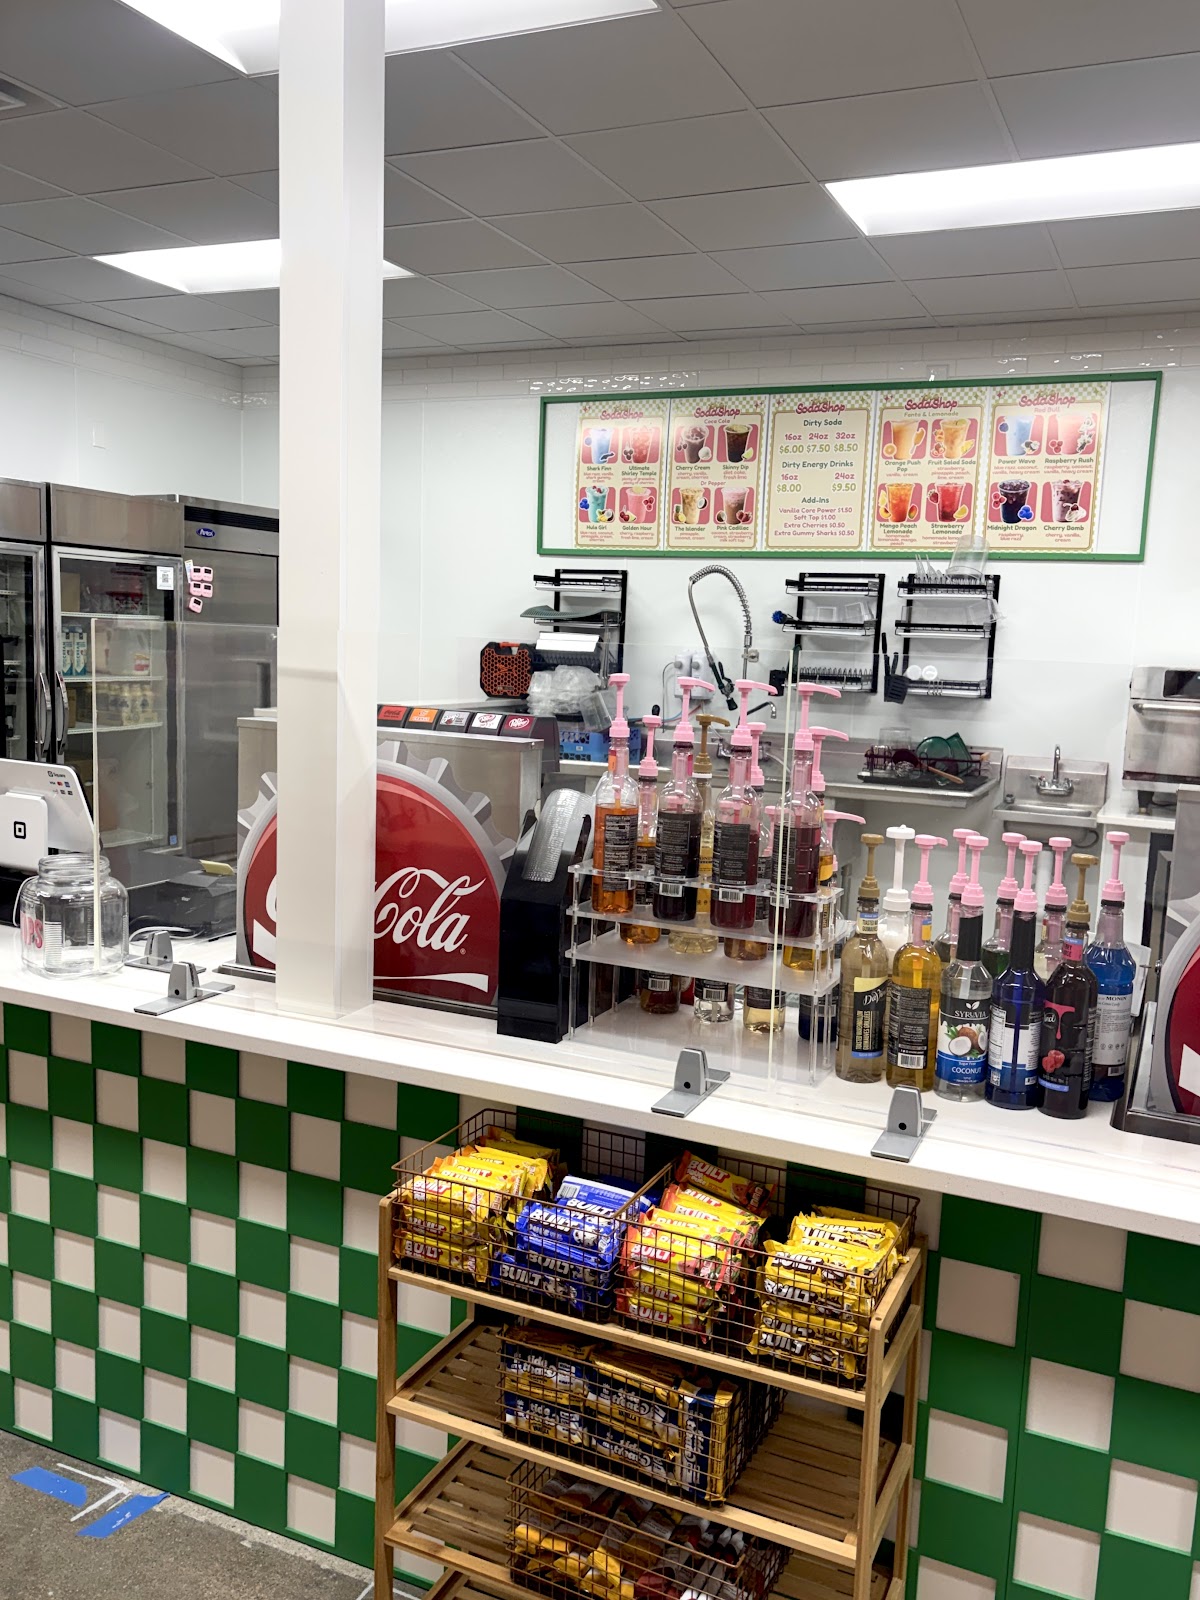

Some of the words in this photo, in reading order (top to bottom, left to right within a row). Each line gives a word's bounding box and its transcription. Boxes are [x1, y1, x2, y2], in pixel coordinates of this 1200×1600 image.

[904, 396, 958, 412] SodaShop
[1018, 392, 1075, 408] SodaShop
[600, 408, 644, 422] SodaShop
[693, 406, 741, 420] SodaShop
[795, 401, 846, 416] SodaShop
[803, 419, 822, 427] Dirty
[808, 432, 829, 440] 24oz
[779, 444, 804, 454] $6.00
[806, 443, 831, 453] $7.50
[833, 443, 859, 452] $8.50
[781, 461, 800, 470] Dirty
[801, 460, 829, 470] Energy
[829, 460, 854, 468] Drinks
[834, 472, 855, 480] 24oz
[776, 483, 802, 493] $8.00
[832, 483, 857, 492] $9.50
[954, 1010, 987, 1018] SYRUVIA
[951, 1066, 982, 1074] COCONUT
[686, 1160, 730, 1181] BUILT
[413, 1179, 451, 1195] BUILT
[684, 1188, 723, 1207] BUILT
[566, 1198, 614, 1216] BUILT
[529, 1208, 574, 1233] BUILT
[404, 1240, 443, 1259] BUILT
[631, 1243, 675, 1262] BUILT
[526, 1250, 573, 1275] BUILT
[773, 1251, 823, 1272] BUILT
[500, 1264, 542, 1287] BUILT
[634, 1281, 679, 1302] BUILT
[764, 1279, 817, 1304] BUILT
[629, 1303, 674, 1323] BUILT
[760, 1333, 807, 1355] BUILT
